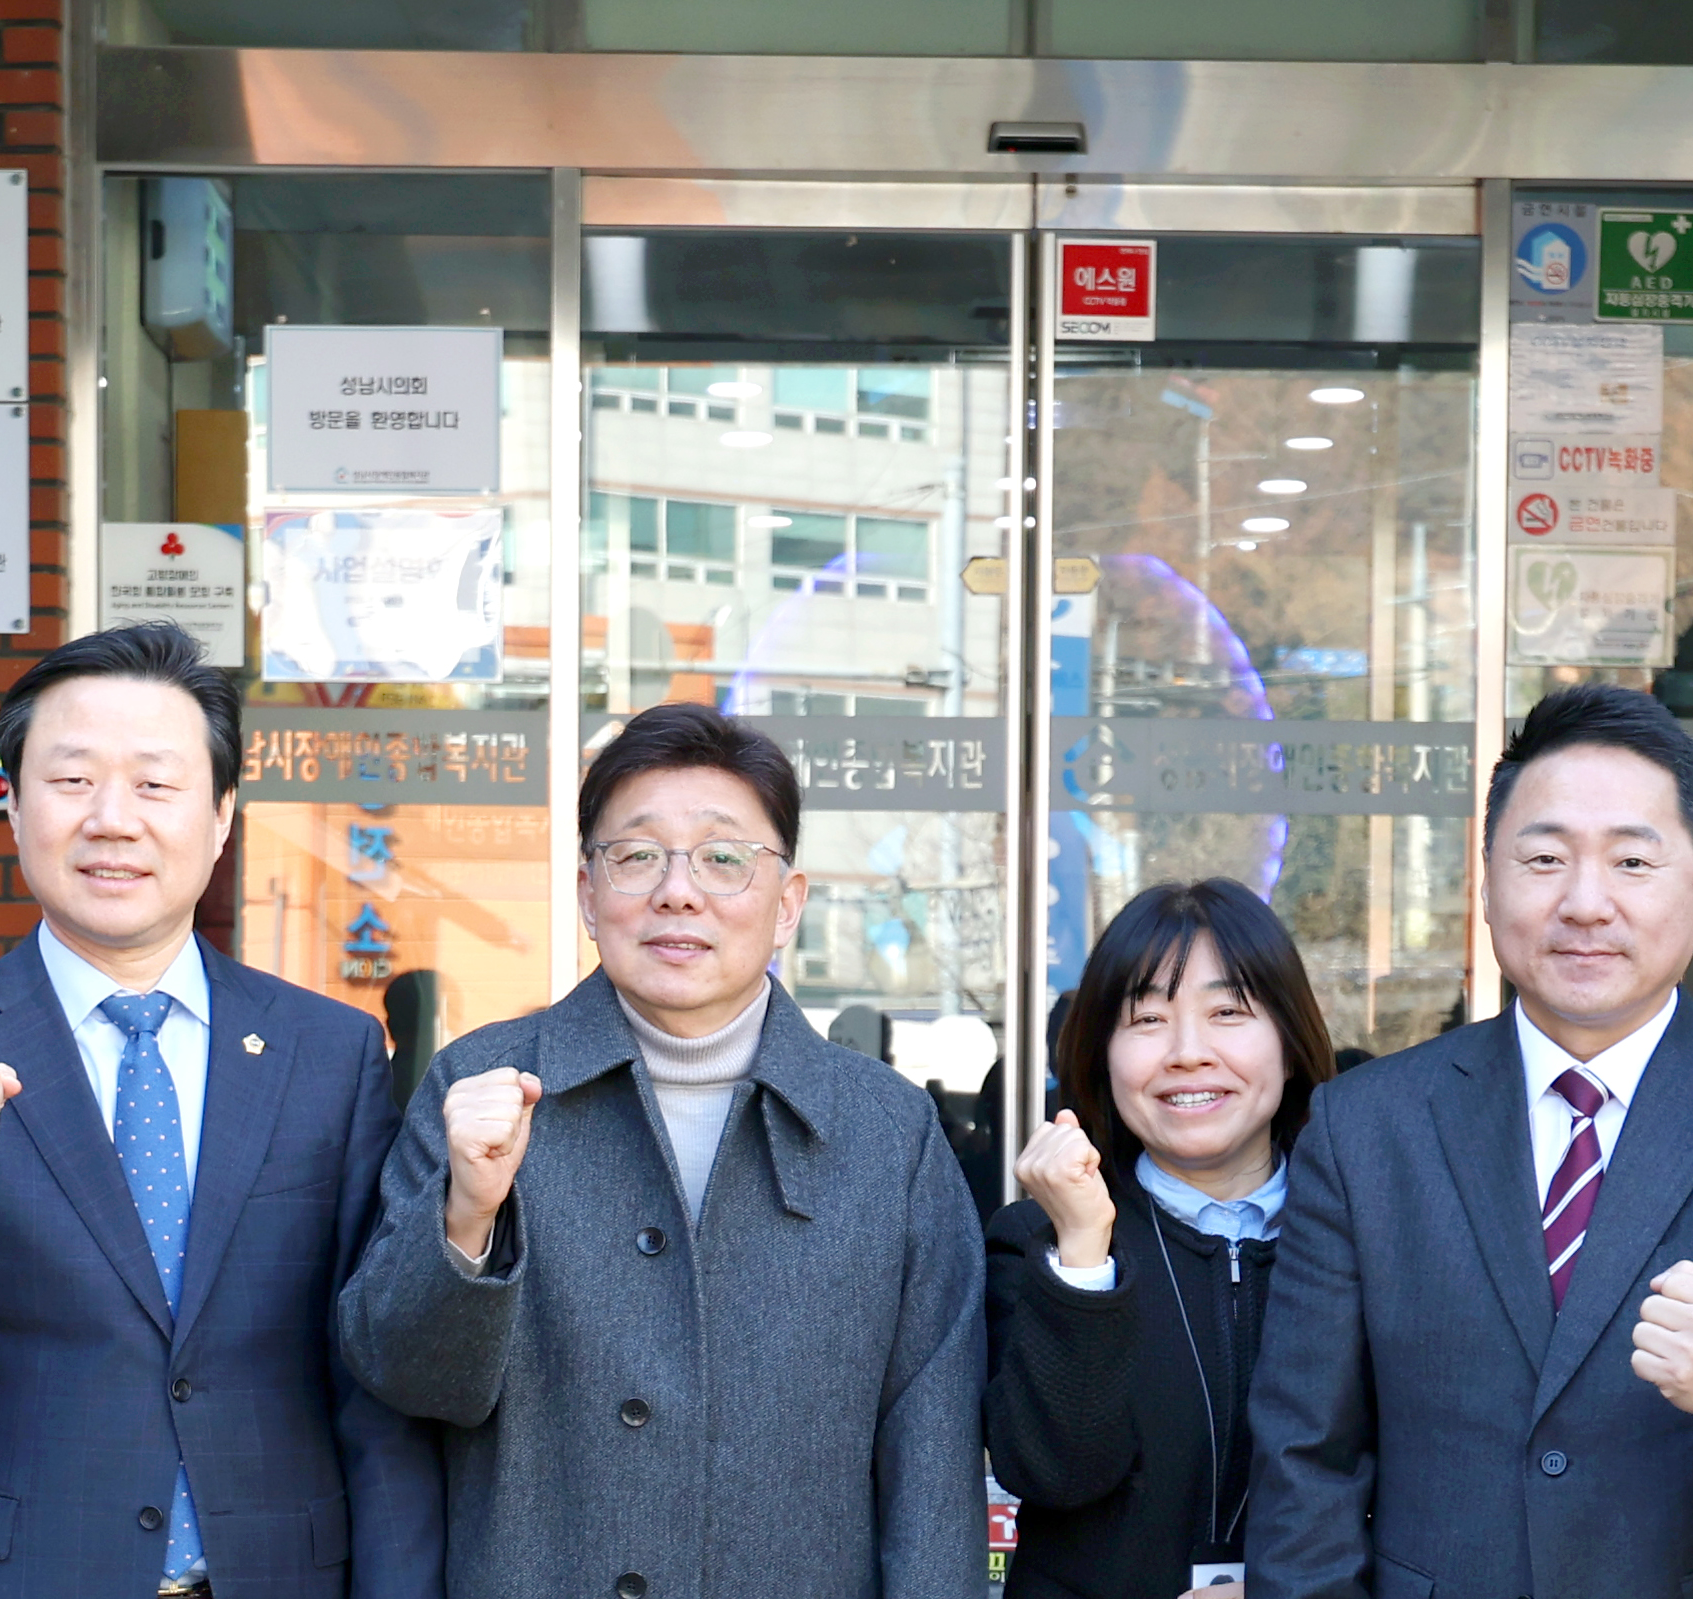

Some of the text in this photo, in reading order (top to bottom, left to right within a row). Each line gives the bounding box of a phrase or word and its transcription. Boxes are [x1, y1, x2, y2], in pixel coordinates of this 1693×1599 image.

[1074, 266, 1136, 292] 에스원
[1631, 276, 1673, 290] AED
[1061, 322, 1111, 335] SECOM
[340, 376, 428, 395] 성남시의회
[309, 411, 459, 430] 방문을 환영합니다
[1559, 447, 1655, 474] CCTV녹화중
